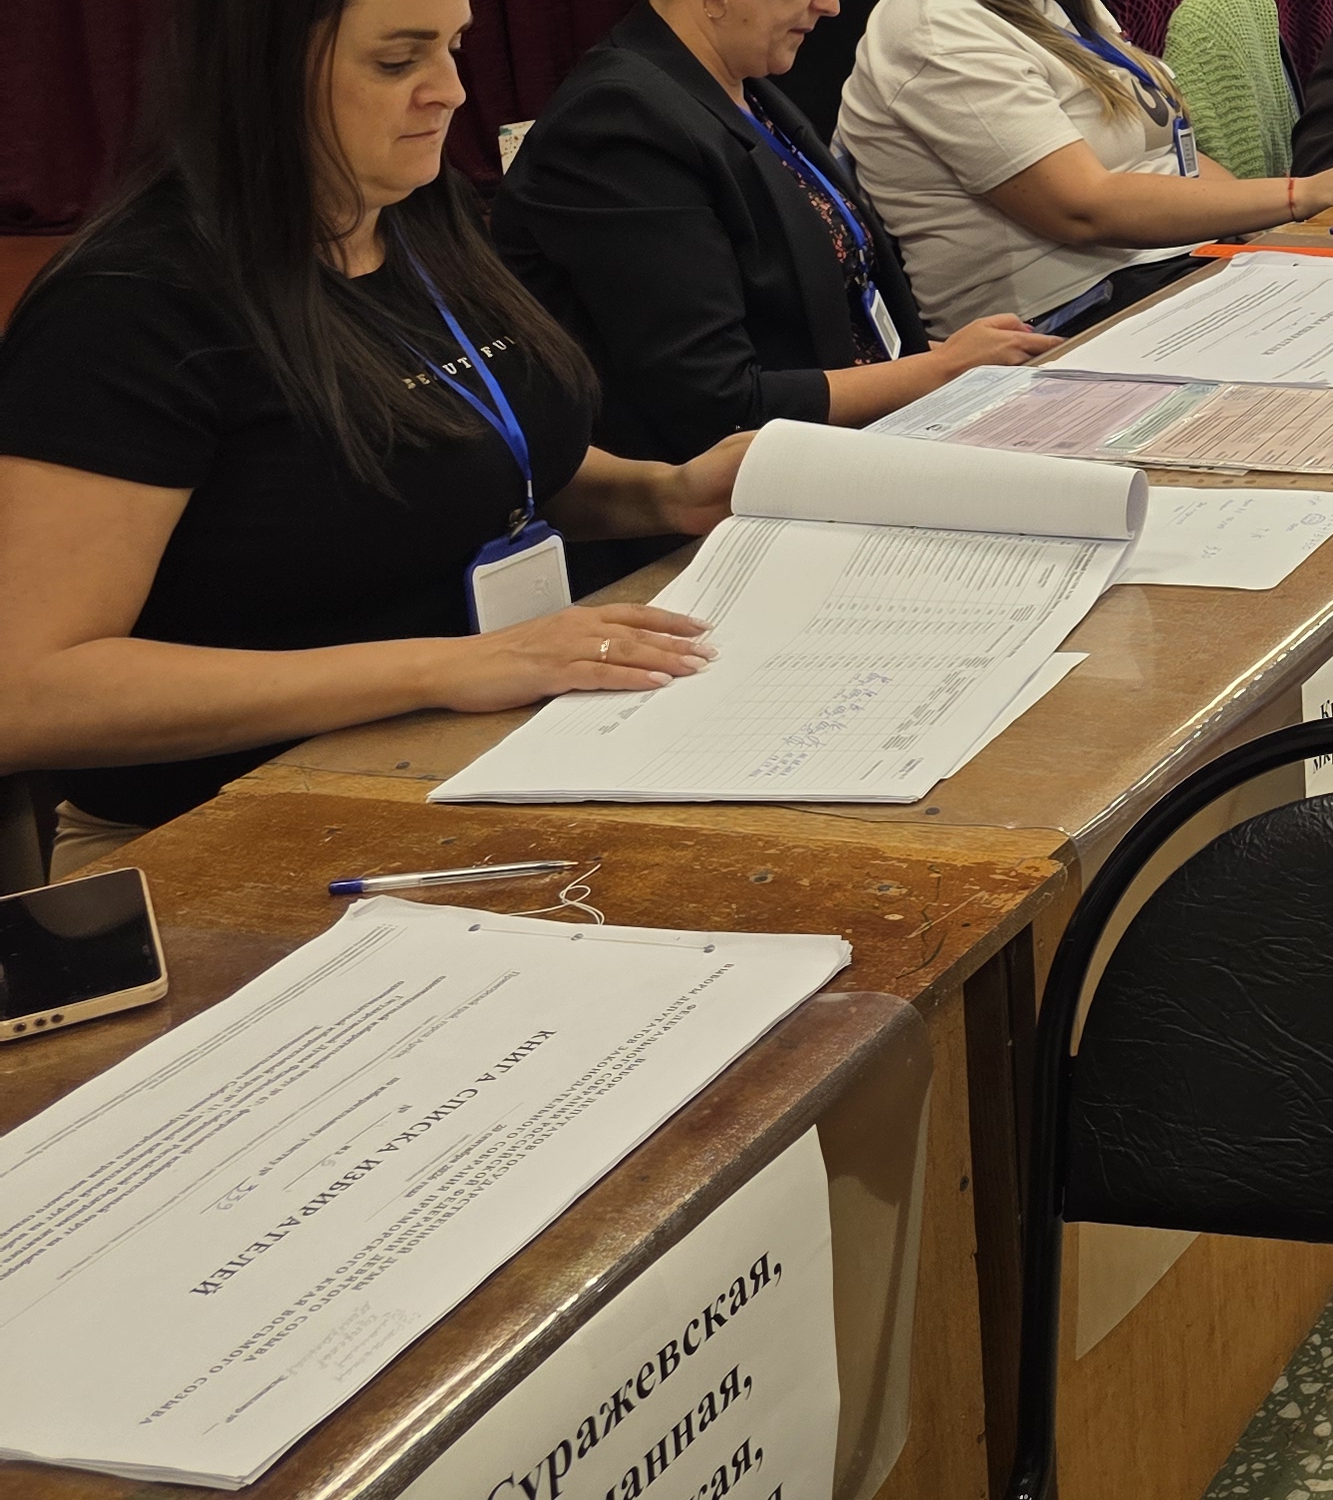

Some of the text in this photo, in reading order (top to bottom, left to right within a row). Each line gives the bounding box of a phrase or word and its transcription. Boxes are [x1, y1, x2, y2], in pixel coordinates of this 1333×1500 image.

[402, 335, 516, 390] BEUTFU
[463, 971, 523, 1005] Приморский
[685, 963, 737, 994] ВЫБОРЫ
[321, 995, 405, 1043] Государственной
[607, 1003, 700, 1070] ФЕДЕРАЛЬНОГО
[622, 995, 695, 1044] ДЕПУТАТОВ
[291, 1044, 331, 1063] Думы
[590, 1057, 648, 1095] ВЫБОРЫ
[181, 1080, 241, 1113] Собрания
[224, 1064, 301, 1109] Федерального
[379, 1076, 404, 1085] по
[502, 1045, 632, 1139] ЗАКОНОДАТЕЛЬНОГО
[546, 1072, 616, 1119] СОБРАНИЯ
[175, 1109, 235, 1142] Собрания
[306, 1086, 390, 1137] избирательному
[520, 1097, 600, 1151] ДЕПУТАТОВ
[83, 1160, 121, 1179] края
[113, 1143, 185, 1186] Российской
[185, 1029, 558, 1296] КНИГА СПИСКА ИЗБИРАТЕЛЕЙ
[264, 1138, 317, 1166] участку
[399, 1123, 510, 1198] 20 сентября 2026 года
[434, 1140, 511, 1192] СОБРАНИЯ
[461, 1121, 555, 1186] РОССИЙСКОЙ
[50, 1186, 123, 1228] Федерации
[206, 1182, 261, 1211] 339
[379, 1188, 471, 1252] ФЕДЕРАЦИИ
[392, 1153, 529, 1254] ГОСУДАРСТВЕННОЙ
[330, 1194, 443, 1274] ПРИМОРСКОГО
[289, 1277, 339, 1306] КРАЯ
[303, 1253, 390, 1313] ДЕВЯТОГО
[347, 1256, 402, 1291] ДУМЫ
[202, 1309, 298, 1374] ВОСЬМОГО
[240, 1315, 313, 1363] СОЗЫВА
[135, 1376, 212, 1426] СОЗЫВА
[601, 1362, 754, 1500] анная,
